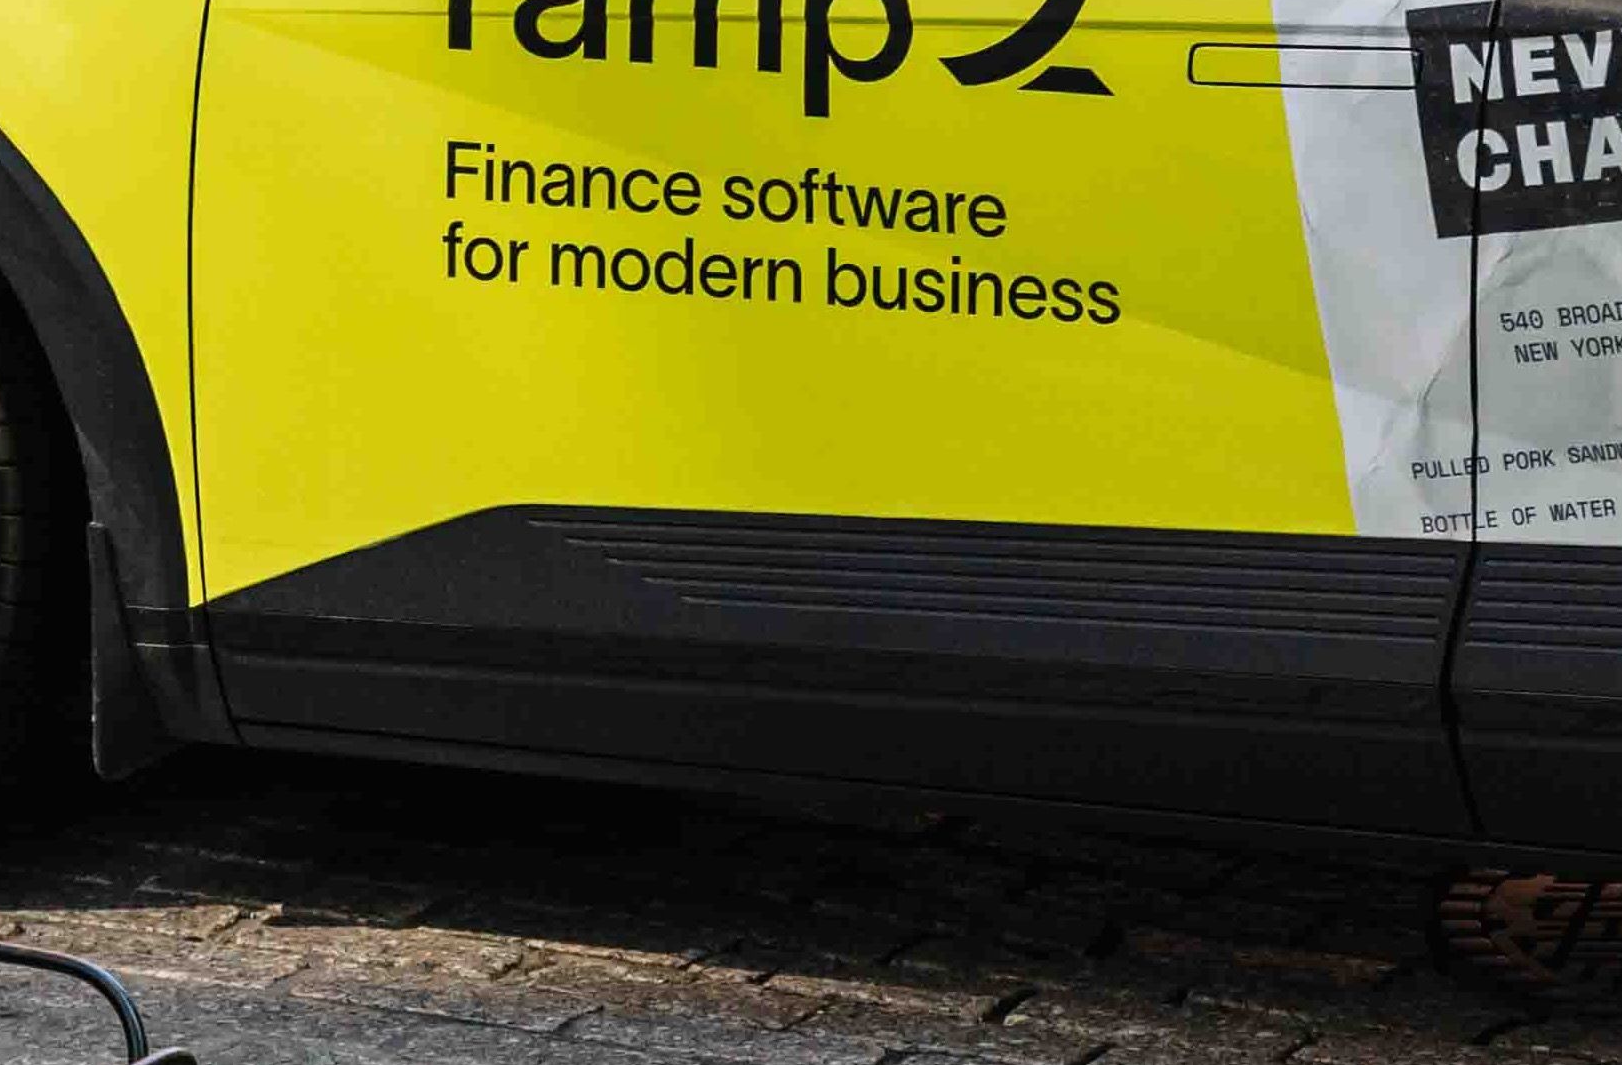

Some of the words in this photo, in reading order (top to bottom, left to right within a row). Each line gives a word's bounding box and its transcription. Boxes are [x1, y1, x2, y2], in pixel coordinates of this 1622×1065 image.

[445, 140, 702, 217] Finance
[722, 167, 1008, 239] software
[441, 221, 530, 283] for
[551, 237, 802, 303] modern
[827, 247, 1122, 326] business
[1500, 309, 1544, 333] 540
[1514, 341, 1559, 364] NEW
[1411, 455, 1490, 480] PULLED
[1503, 448, 1556, 471] PORK
[1511, 506, 1538, 527] OF
[1549, 498, 1617, 523] WATER
